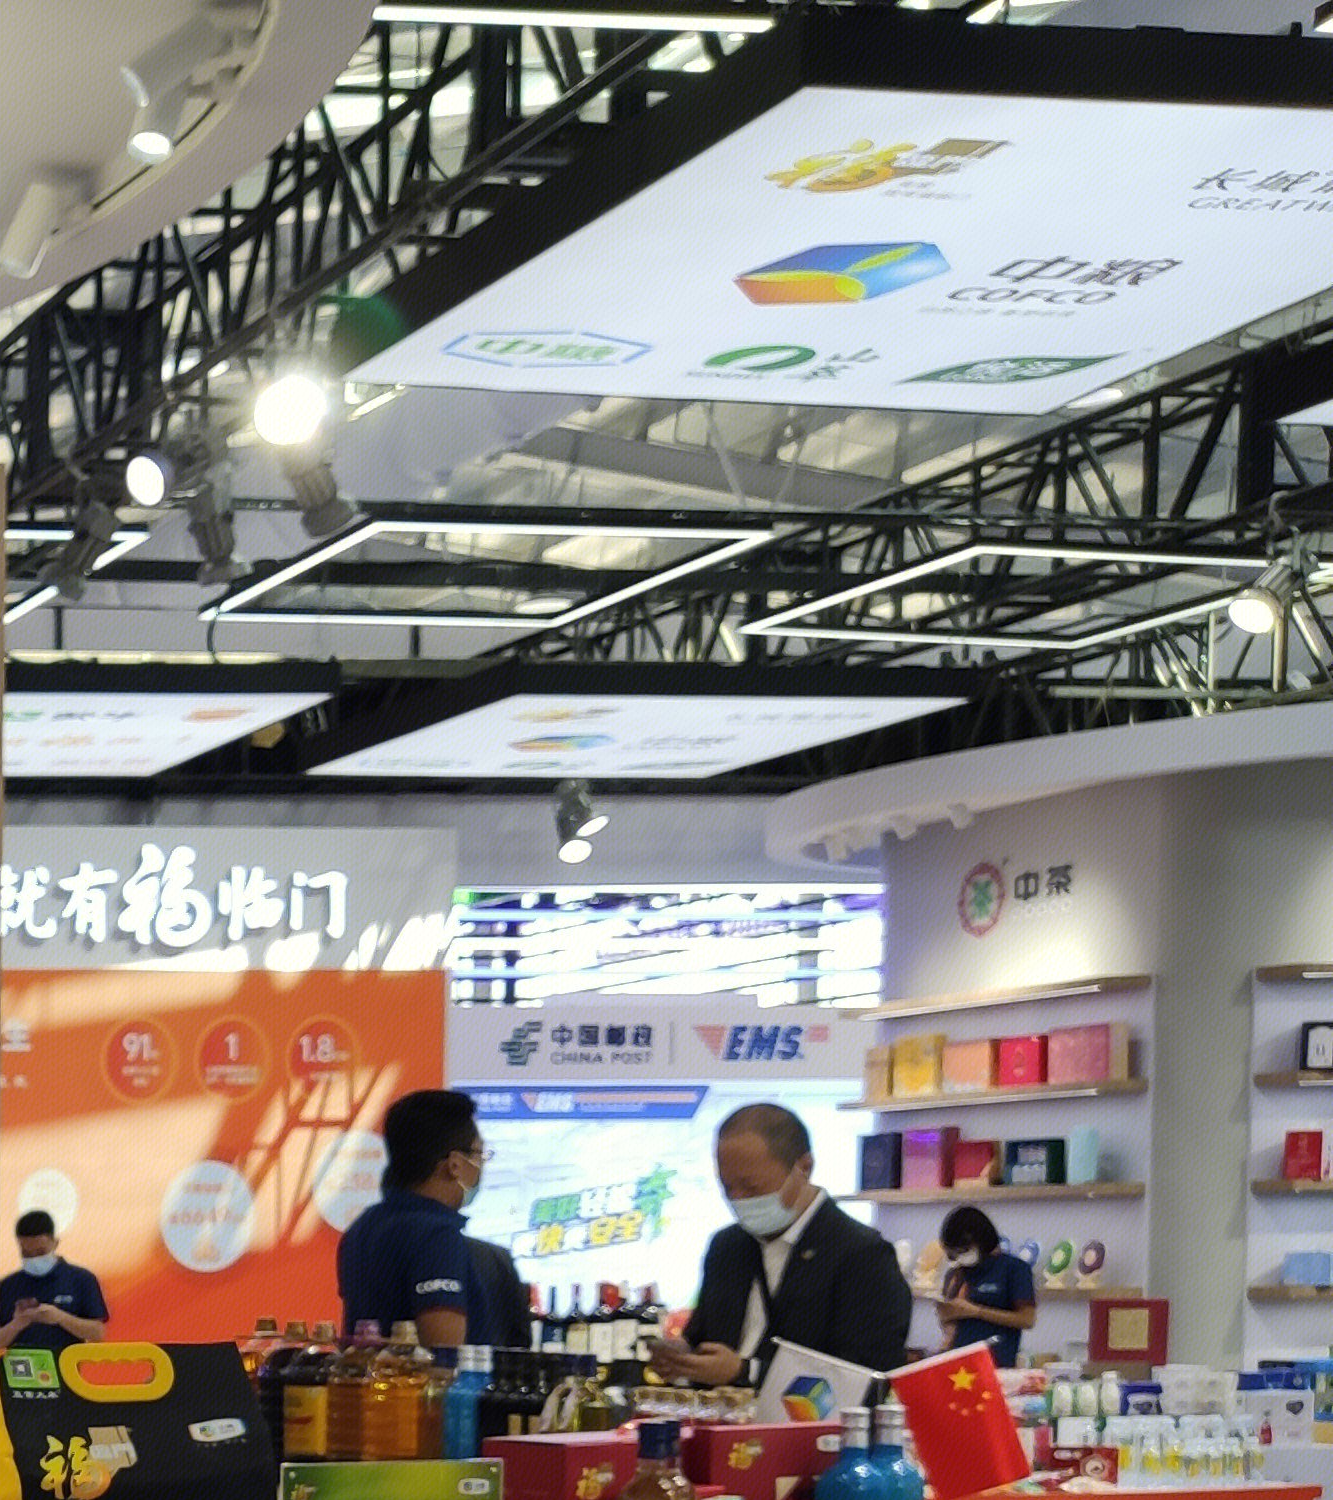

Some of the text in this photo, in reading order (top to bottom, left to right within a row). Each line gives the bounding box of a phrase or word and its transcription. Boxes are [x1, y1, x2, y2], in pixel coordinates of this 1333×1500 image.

[948, 287, 1117, 305] COFCO
[723, 1024, 805, 1061] EMS
[550, 1052, 653, 1066] CHINA POST
